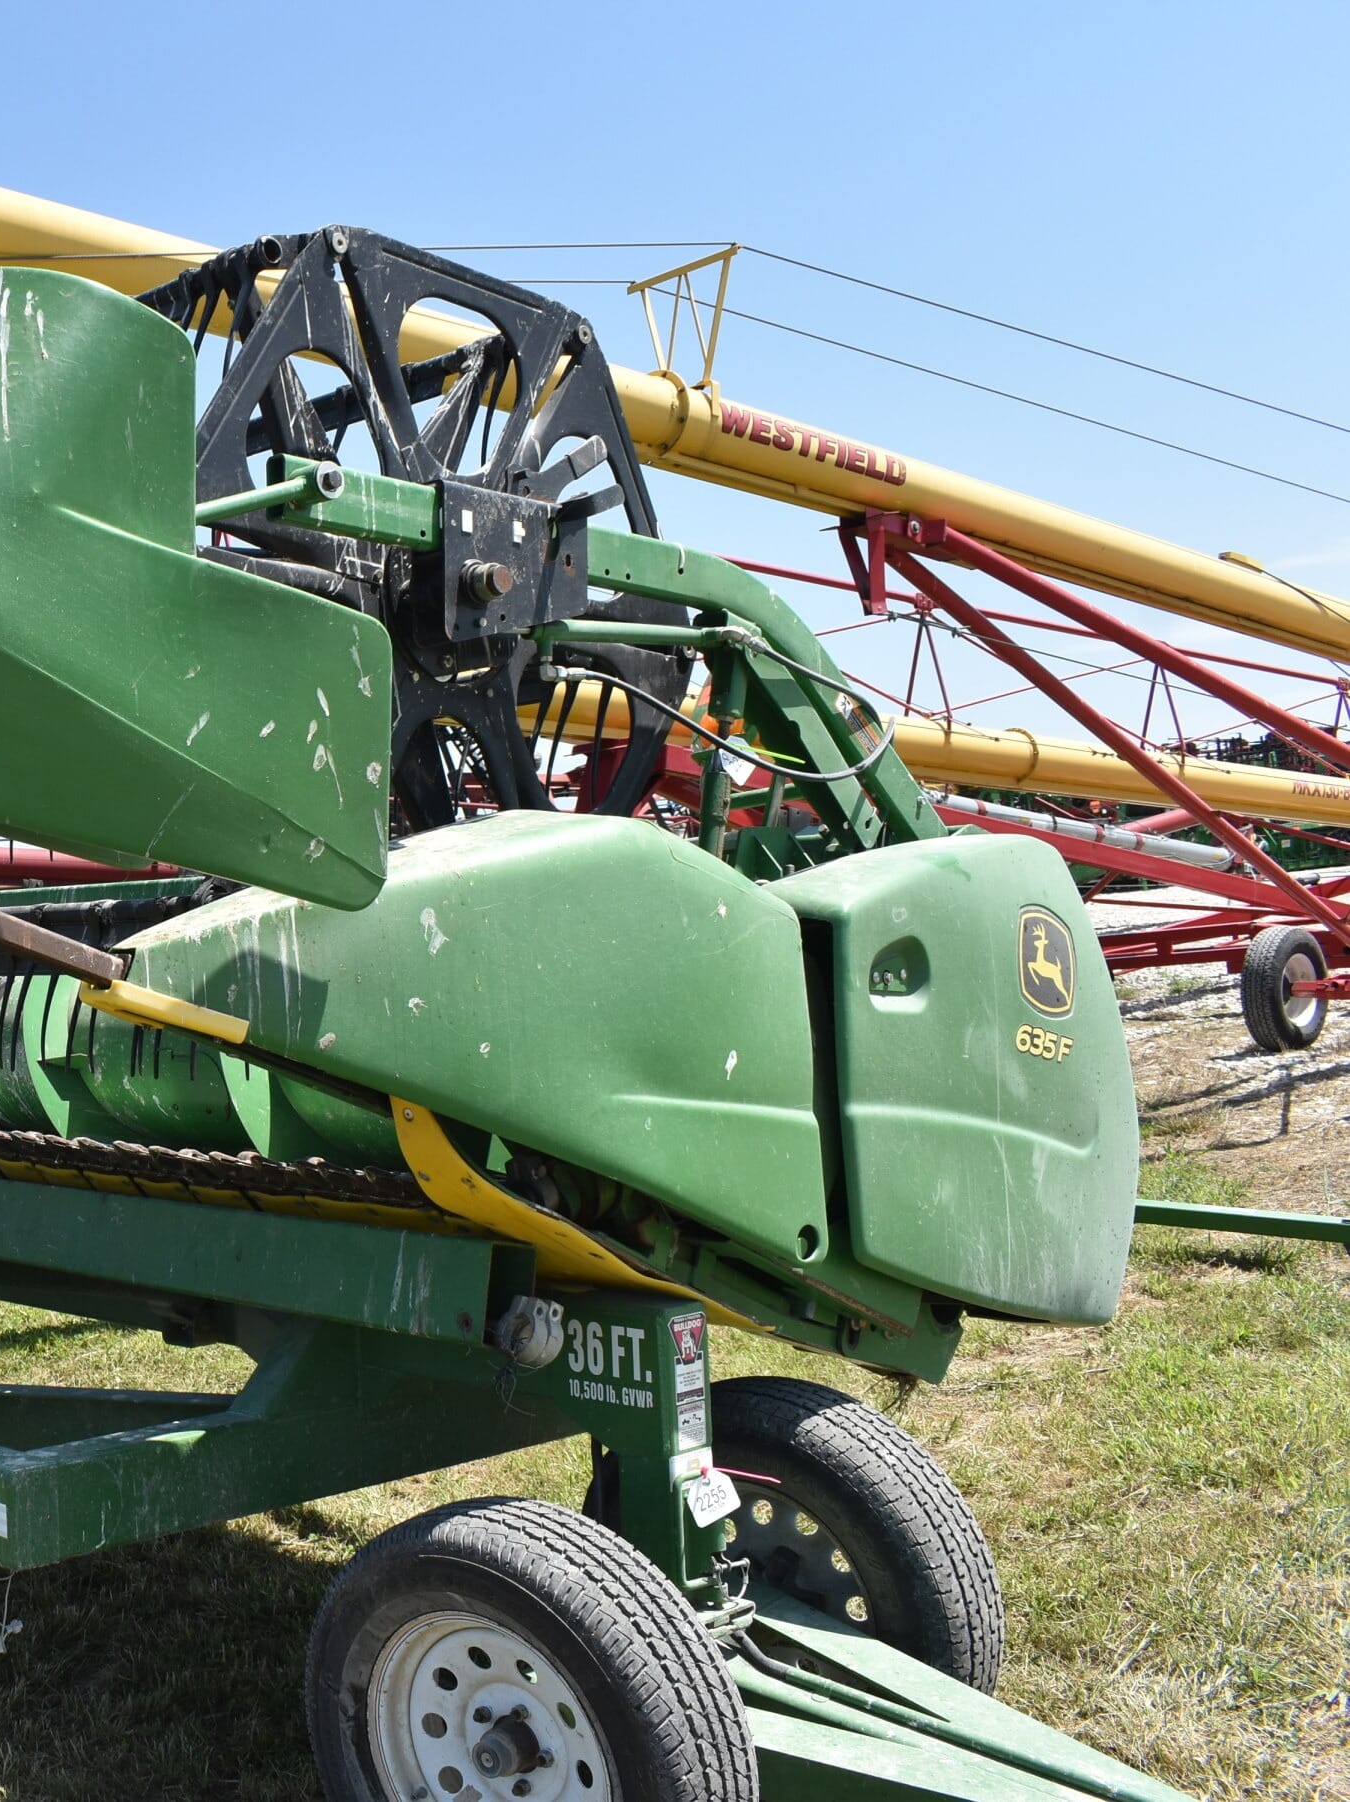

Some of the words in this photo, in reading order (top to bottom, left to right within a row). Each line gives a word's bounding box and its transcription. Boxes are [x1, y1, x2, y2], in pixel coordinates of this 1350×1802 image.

[720, 402, 907, 486] WESTFIELD
[1015, 1023, 1074, 1064] 635F
[673, 1318, 702, 1332] BULLDOG
[567, 1318, 604, 1376] 36
[610, 1325, 653, 1383] FT.
[569, 1378, 604, 1402] 10,500
[606, 1383, 619, 1404] lb.
[621, 1387, 653, 1409] GVWR
[696, 1484, 727, 1512] 2255
